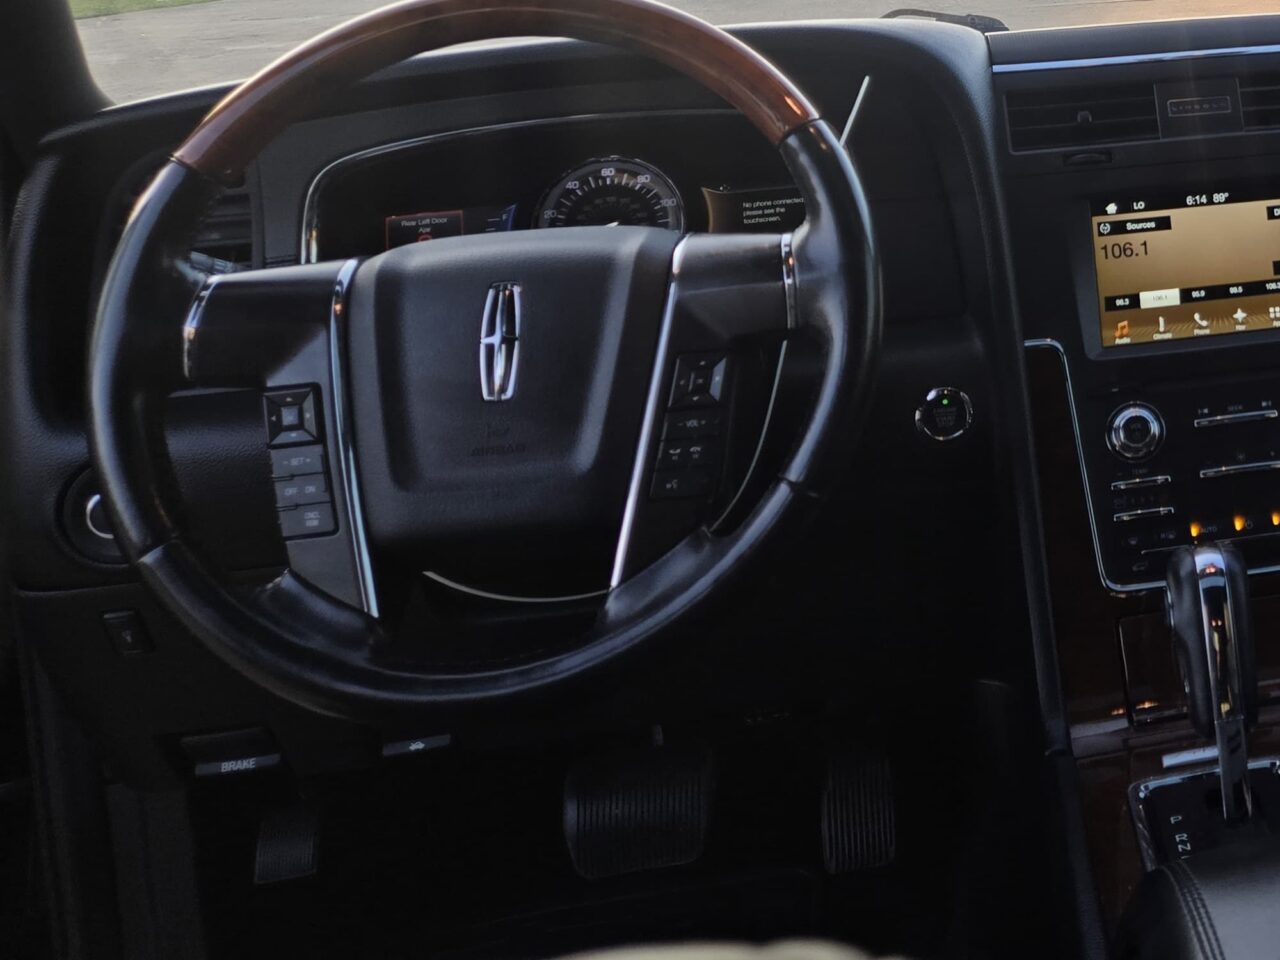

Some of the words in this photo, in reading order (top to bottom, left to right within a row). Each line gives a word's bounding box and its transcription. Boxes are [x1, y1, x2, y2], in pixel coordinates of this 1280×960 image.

[601, 167, 615, 176] 60
[637, 175, 651, 183] 80
[566, 181, 579, 189] 40
[660, 198, 676, 207] 100
[1186, 195, 1207, 206] 6:14
[1133, 201, 1145, 210] LO
[543, 209, 557, 219] 20
[1126, 221, 1156, 230] Sources
[1101, 240, 1149, 260] 106.1
[221, 757, 256, 773] BRAKE
[1170, 815, 1182, 824] P
[1175, 833, 1188, 842] R
[1178, 842, 1191, 852] N
